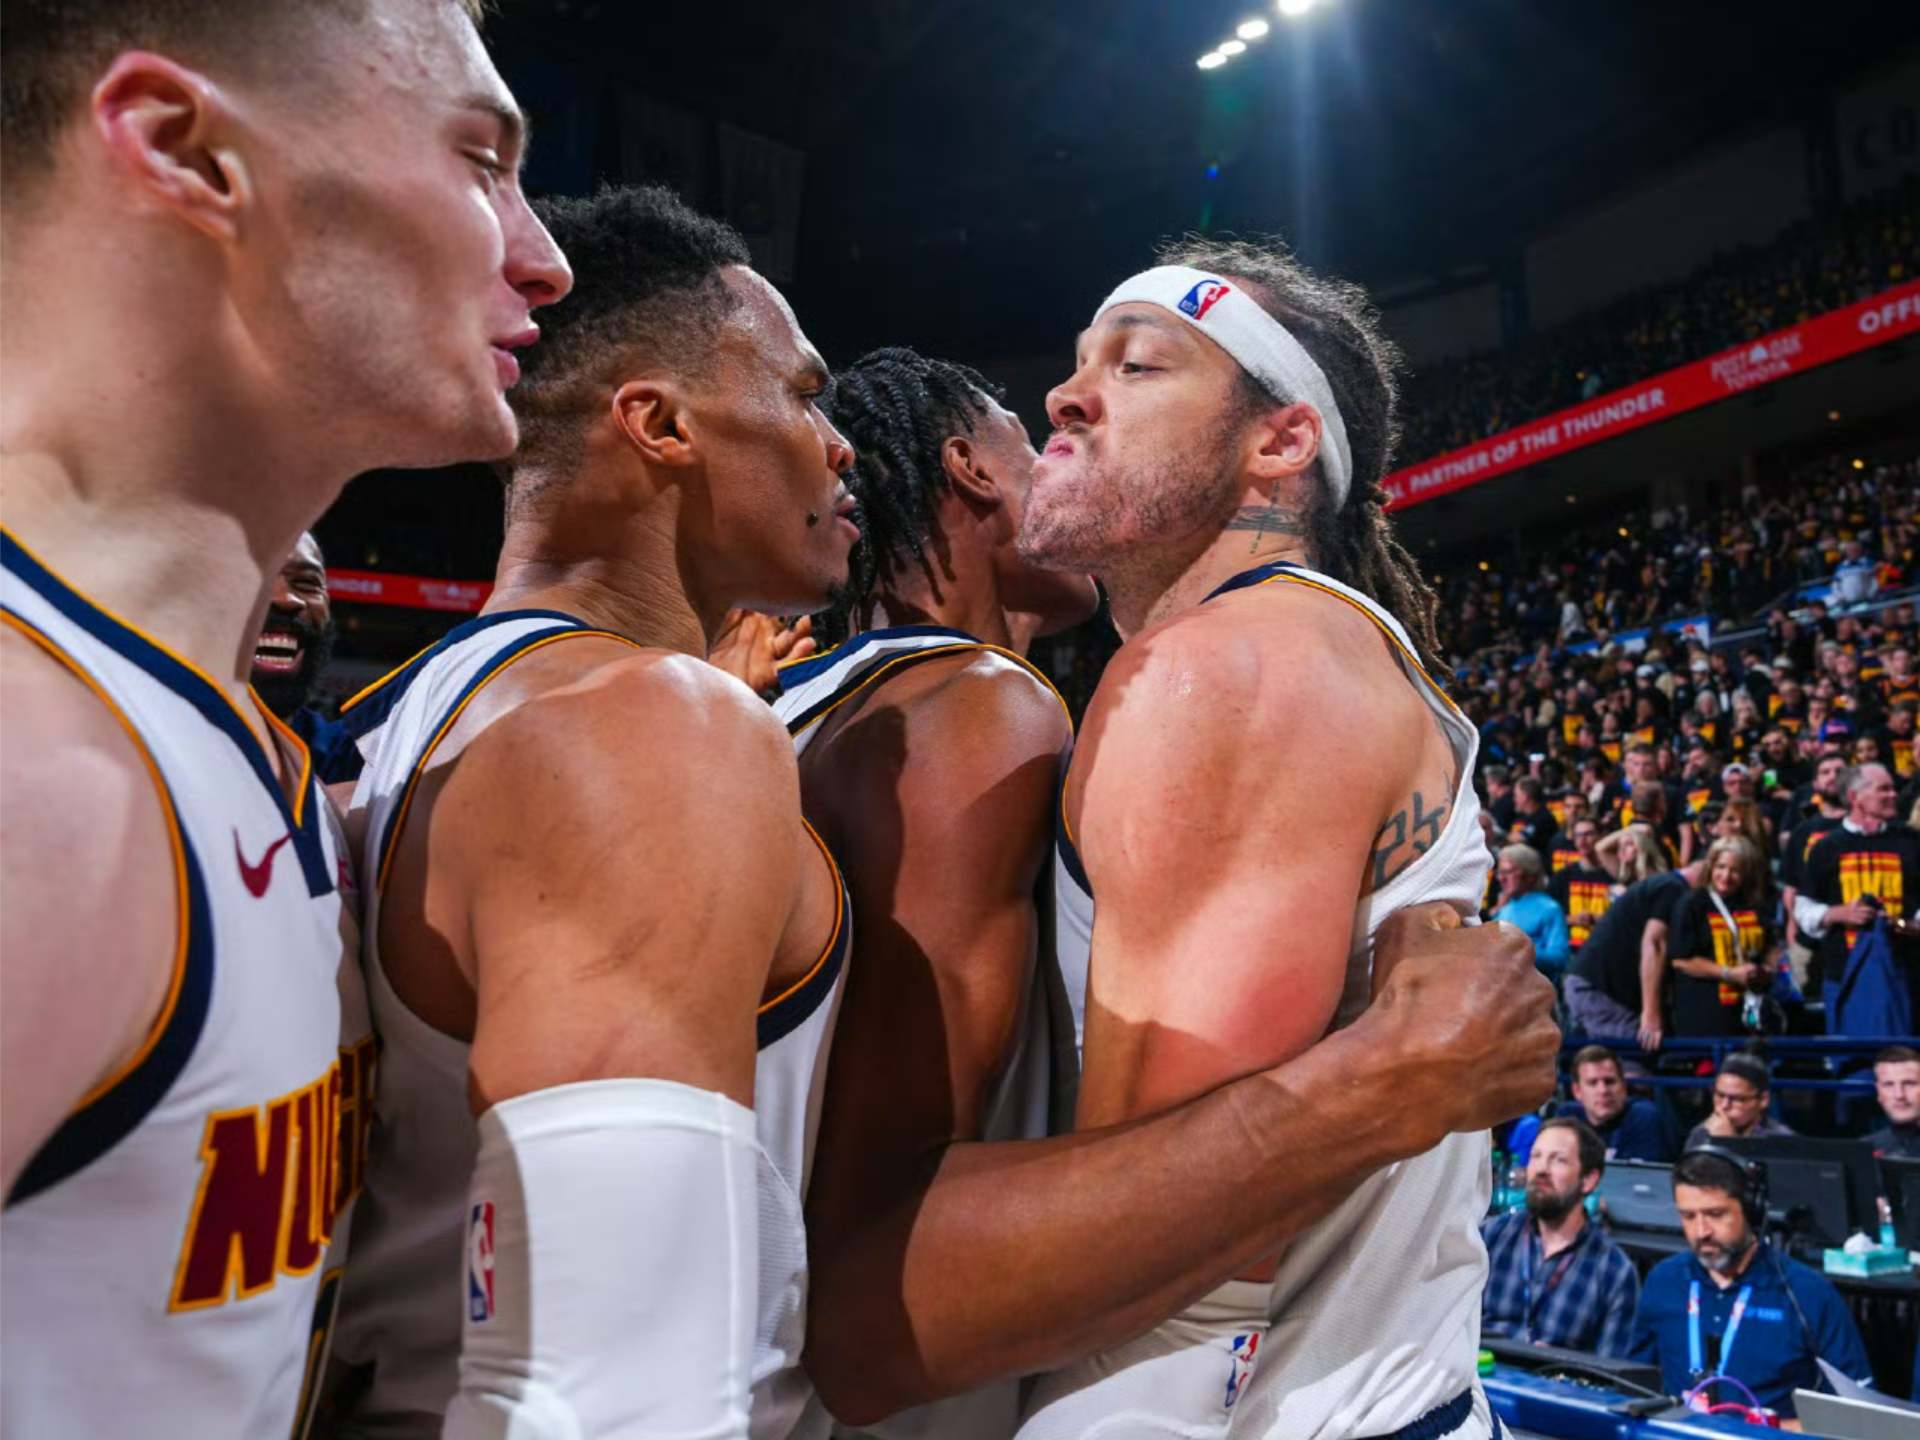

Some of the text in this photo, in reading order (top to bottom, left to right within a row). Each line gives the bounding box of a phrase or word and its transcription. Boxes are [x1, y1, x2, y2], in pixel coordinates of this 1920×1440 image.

[1726, 359, 1791, 391] TOYOTA
[1410, 449, 1490, 493] PARTNER
[1492, 441, 1518, 464] OF
[1522, 426, 1559, 454] THE
[1563, 388, 1666, 439] THUNDER
[1373, 792, 1445, 891] 25
